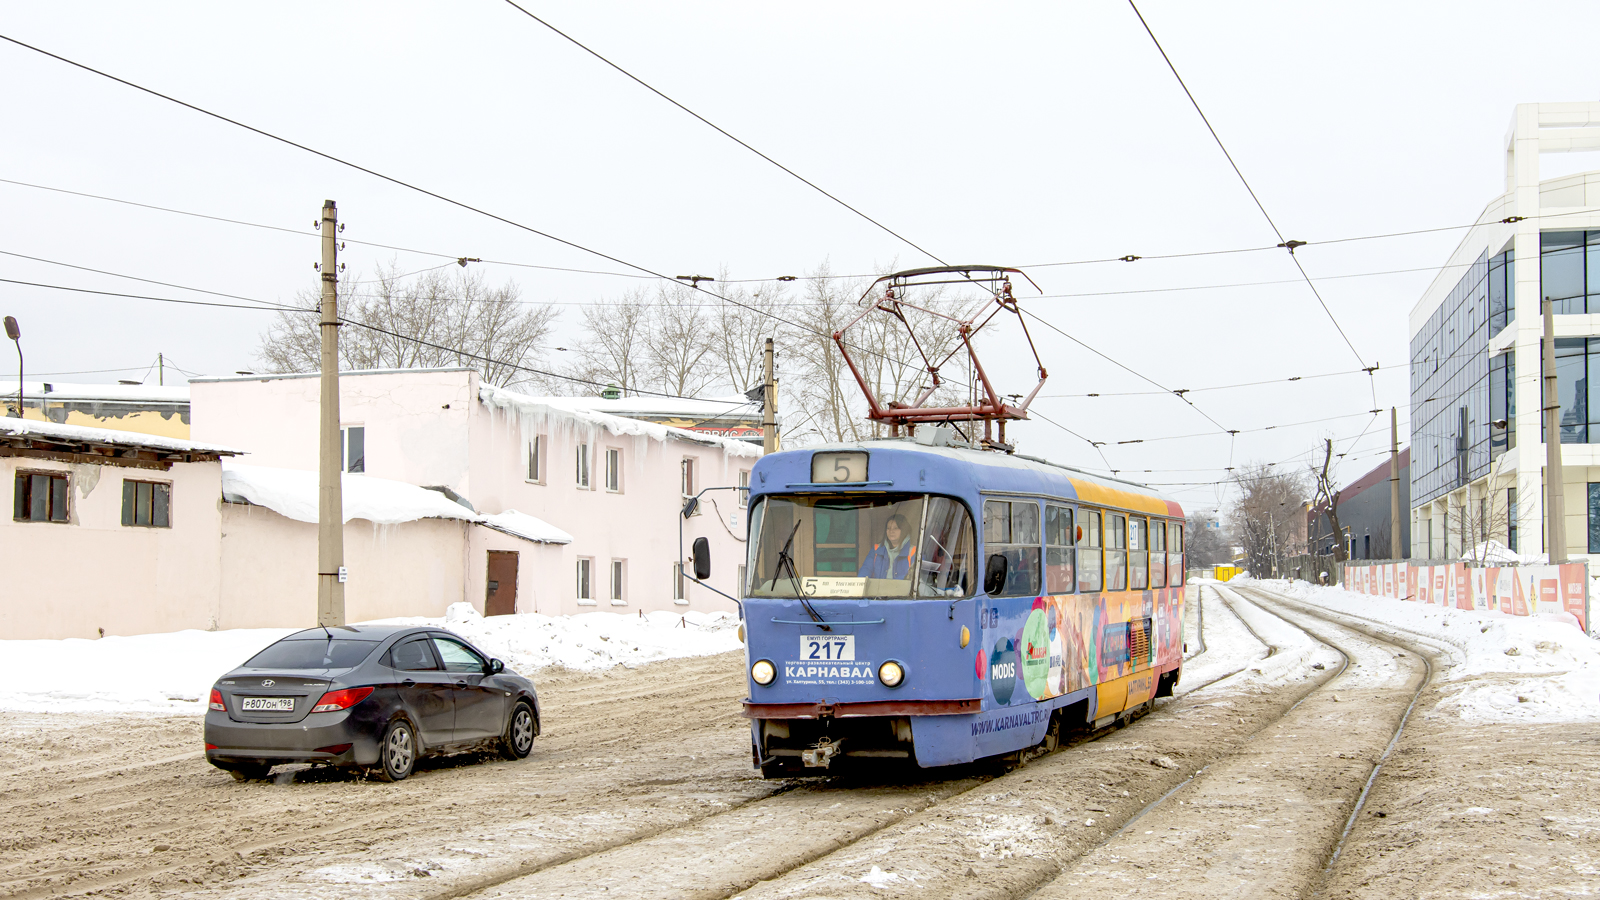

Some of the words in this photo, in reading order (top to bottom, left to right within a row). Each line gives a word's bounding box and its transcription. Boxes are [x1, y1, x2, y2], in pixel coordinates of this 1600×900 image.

[833, 457, 851, 482] 5
[805, 579, 818, 596] 5
[808, 641, 846, 660] 217
[785, 666, 874, 678] КАРНАВАЛ
[992, 662, 1015, 680] MODIS
[278, 699, 292, 707] 198
